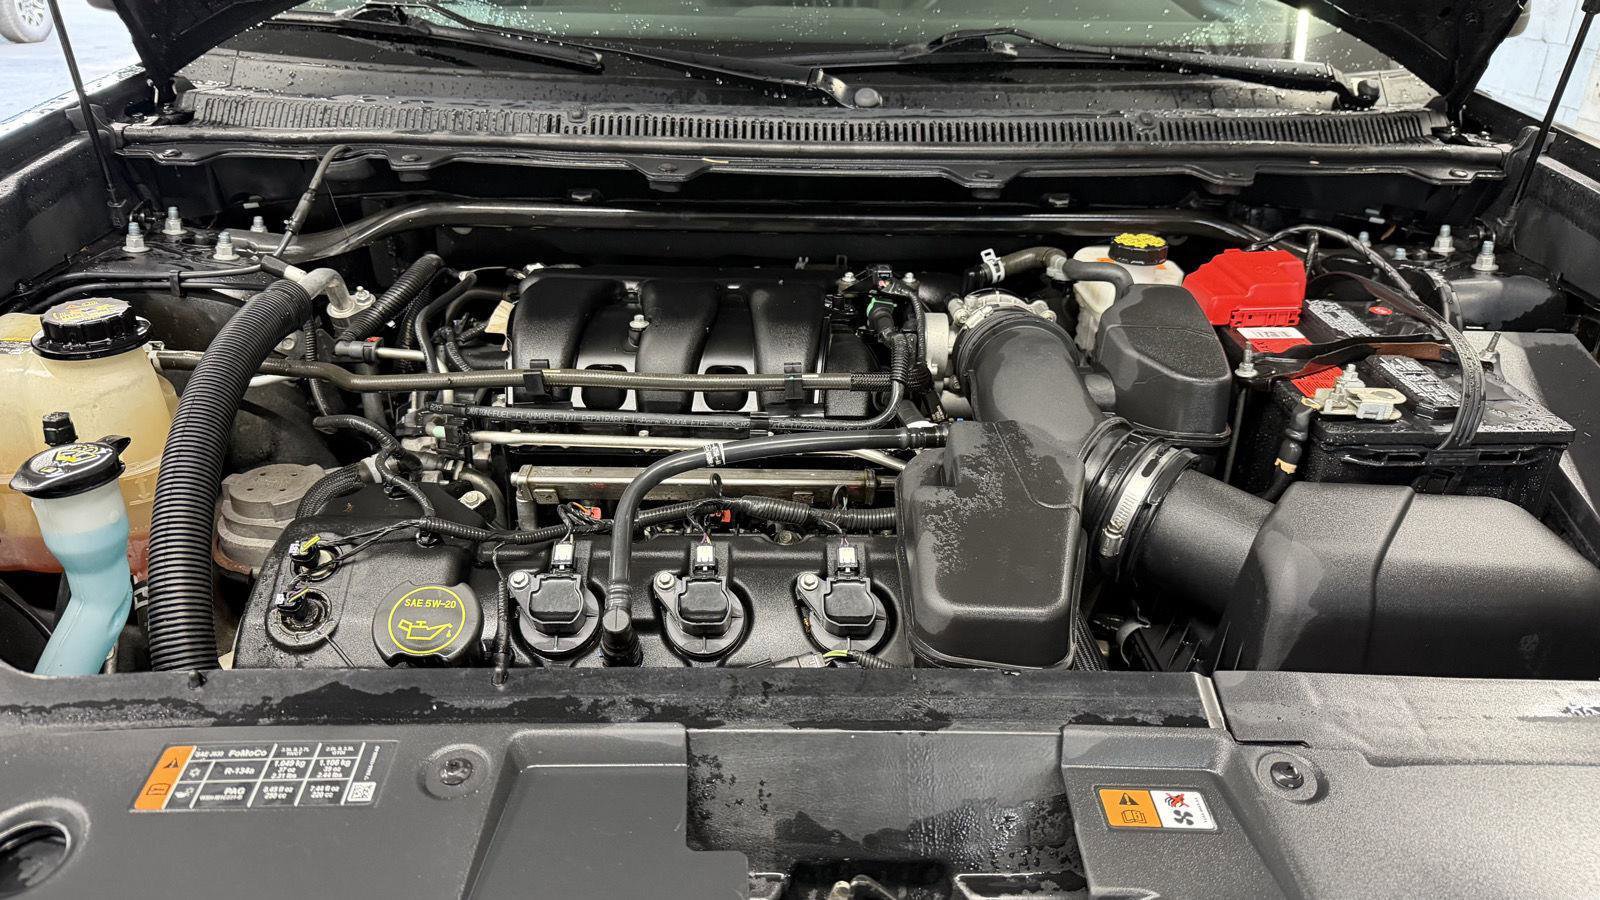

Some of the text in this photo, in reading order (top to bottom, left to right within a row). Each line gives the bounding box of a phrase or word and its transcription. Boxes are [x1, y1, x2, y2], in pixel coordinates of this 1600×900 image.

[404, 599, 456, 608] SAE 5W-20
[228, 749, 267, 757] FoMoCo
[295, 760, 306, 768] kg
[340, 760, 351, 768] kg
[224, 767, 255, 775] R-134a
[223, 787, 246, 795] PAG
